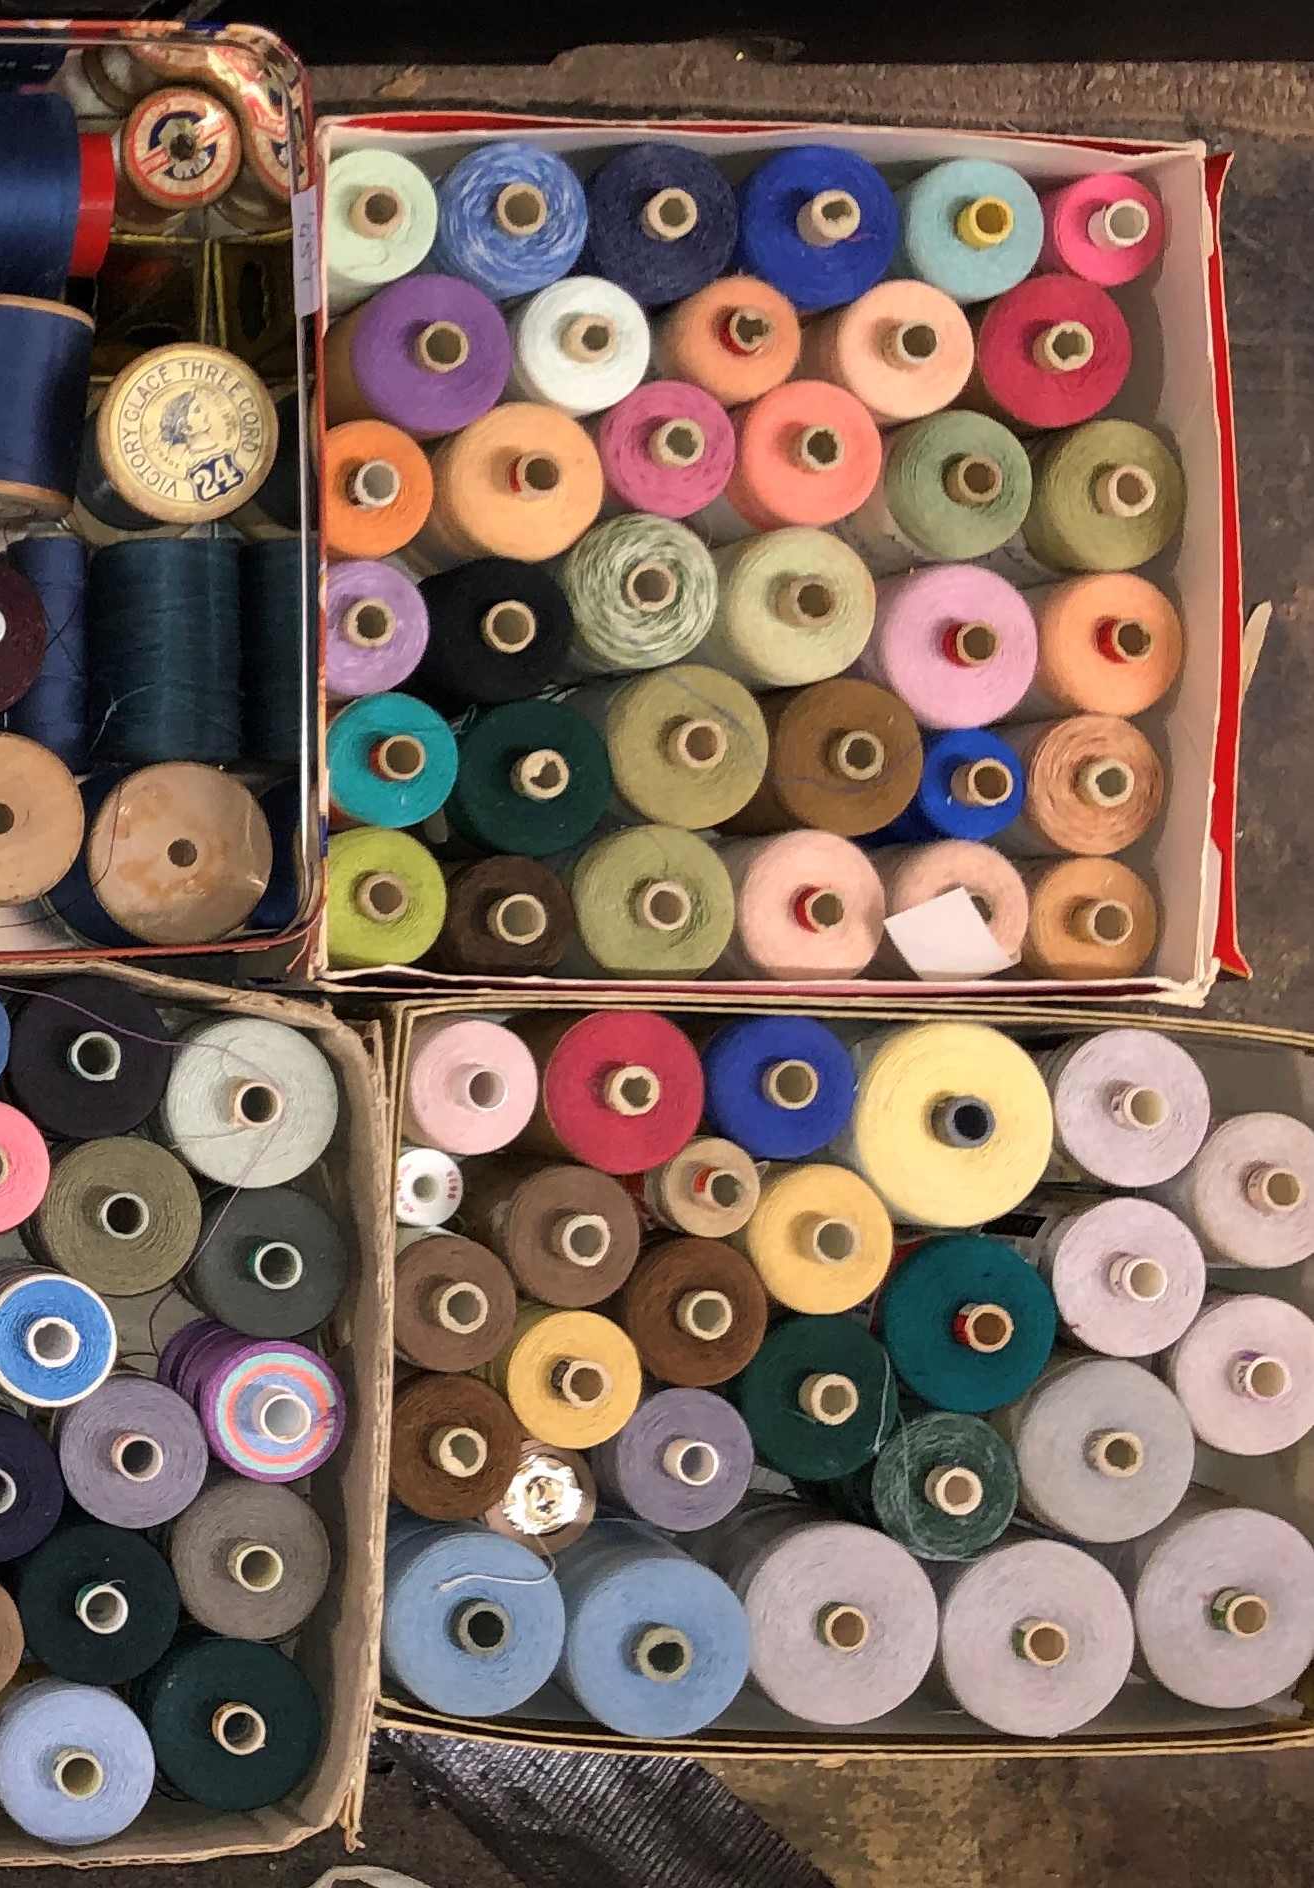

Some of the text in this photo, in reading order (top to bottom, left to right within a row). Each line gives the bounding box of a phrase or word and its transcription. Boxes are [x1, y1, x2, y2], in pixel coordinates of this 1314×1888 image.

[123, 427, 177, 499] VICTORY
[177, 361, 243, 399] THREE
[237, 397, 262, 453] CORD
[193, 456, 242, 500] 24
